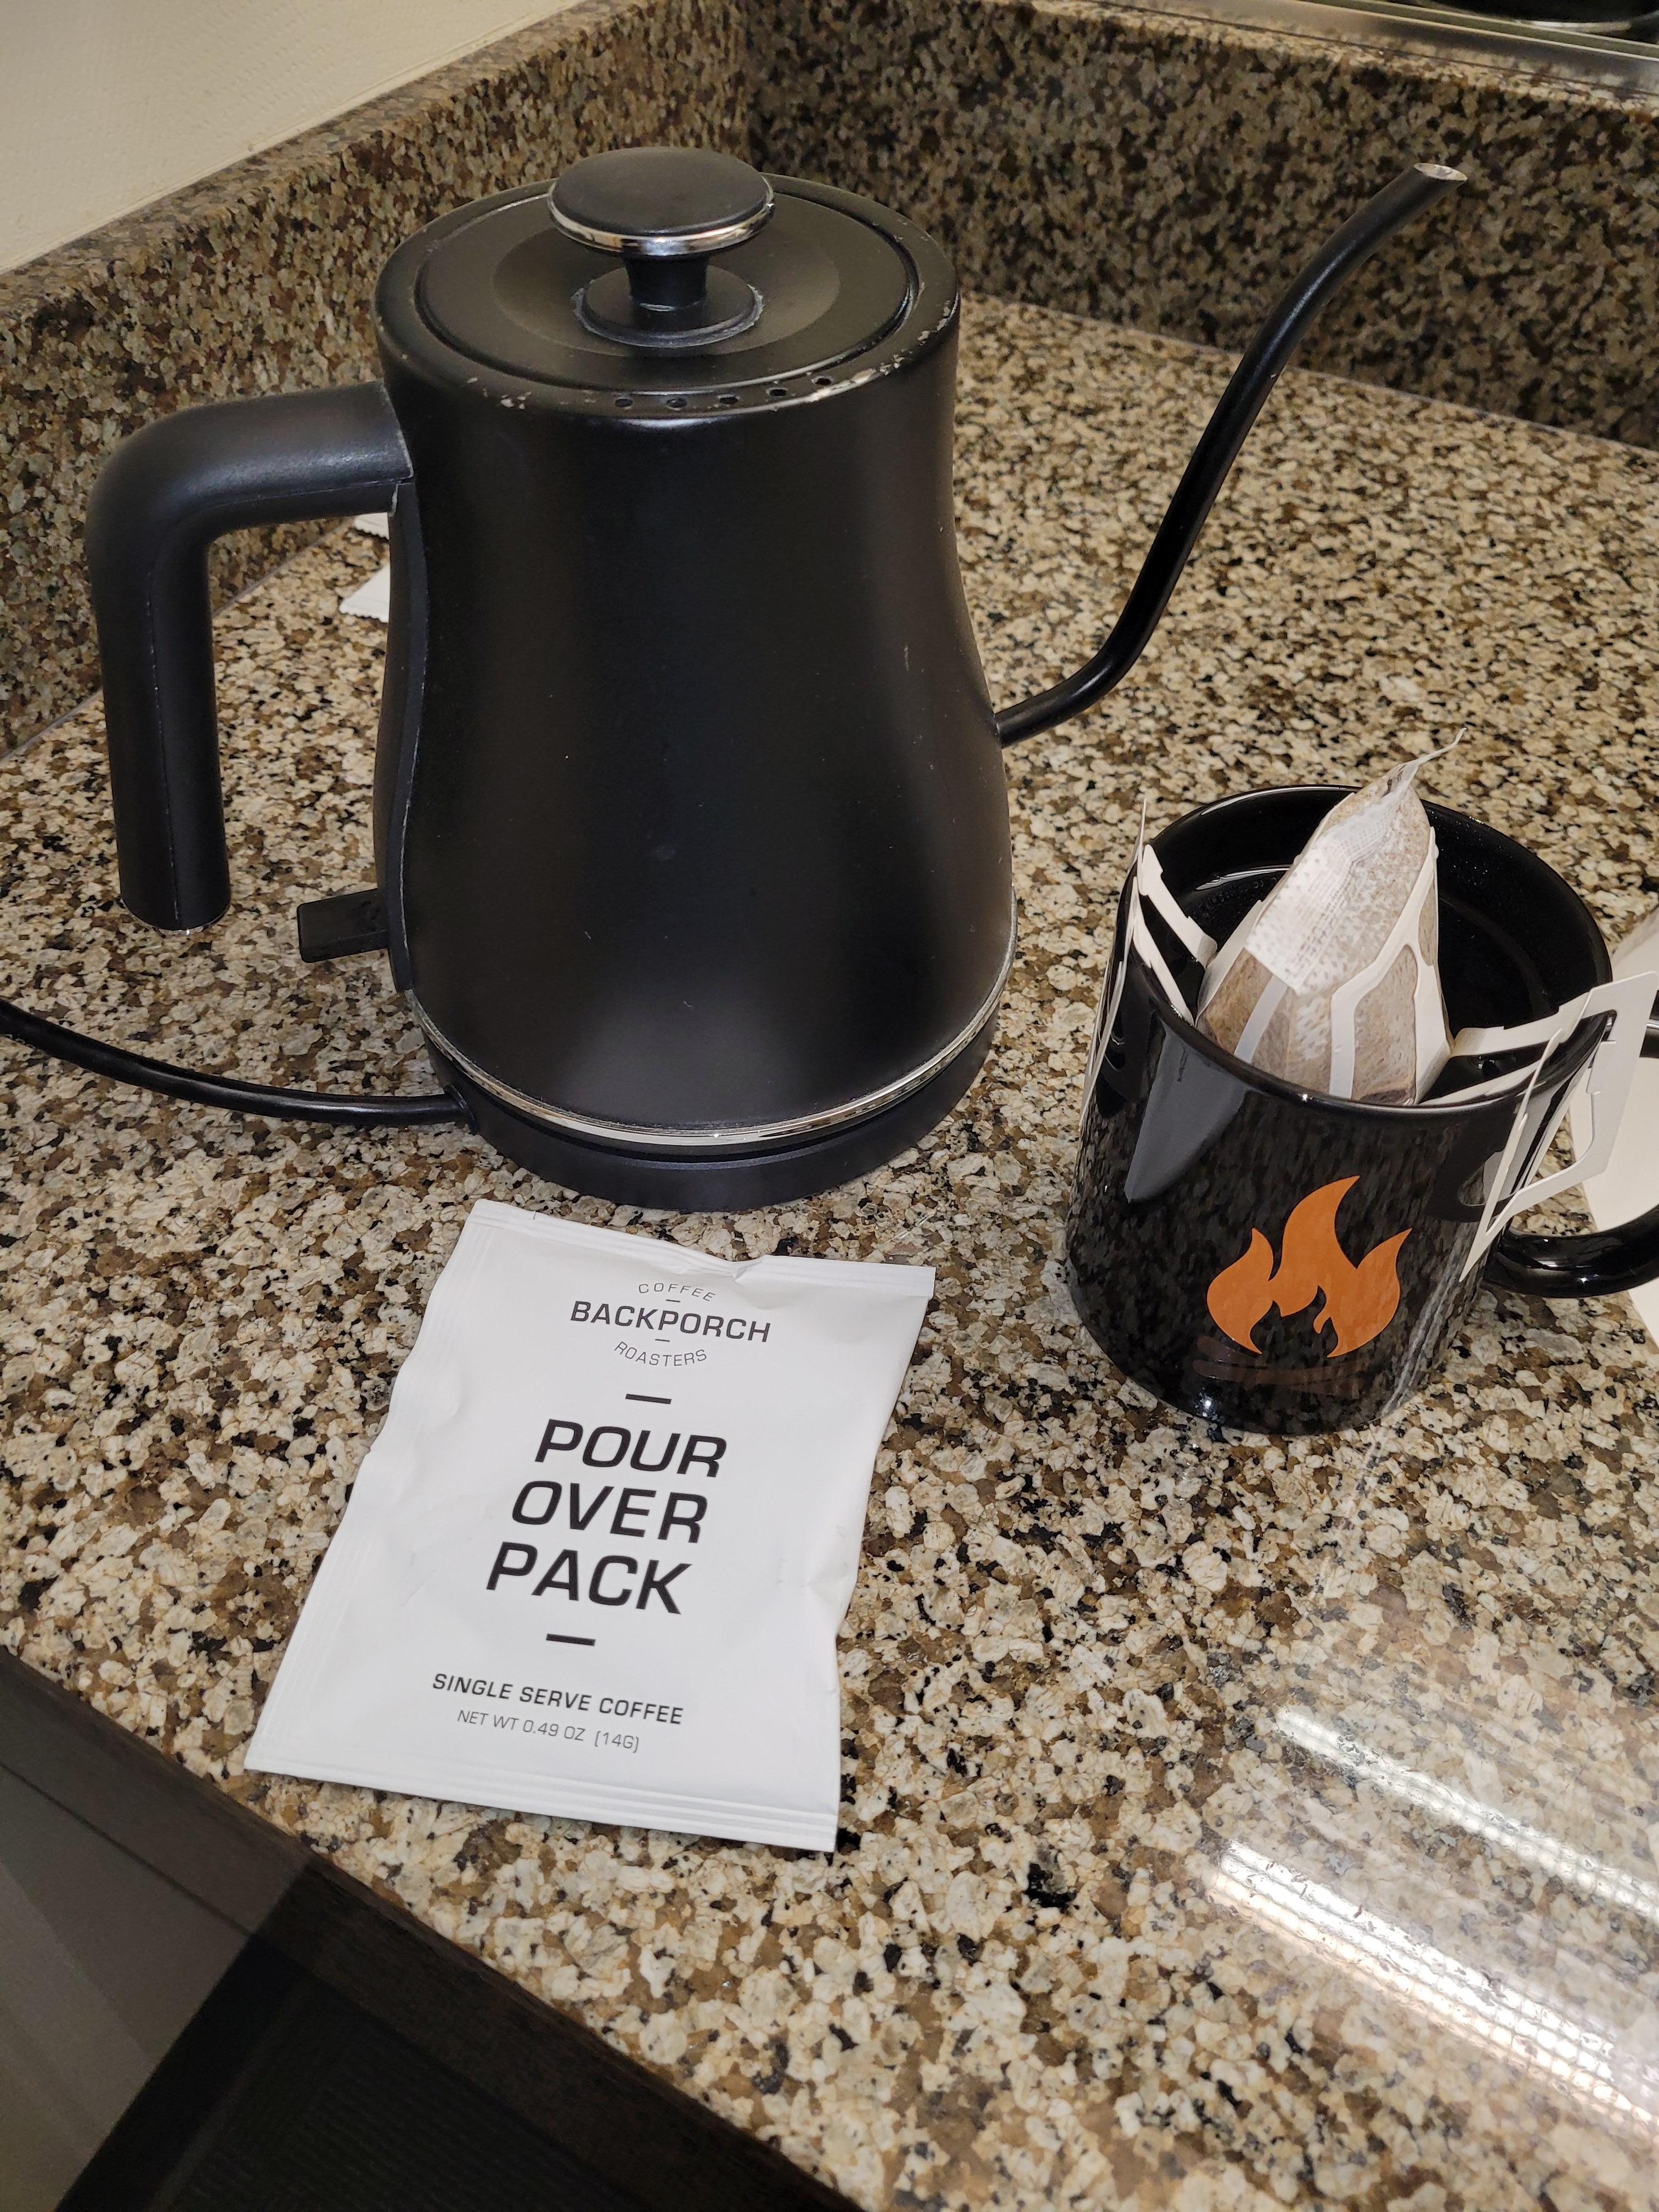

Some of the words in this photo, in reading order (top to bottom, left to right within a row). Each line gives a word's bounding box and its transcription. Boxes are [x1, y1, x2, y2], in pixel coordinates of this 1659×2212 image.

[638, 1282, 716, 1302] COFFEE
[569, 1300, 771, 1344] BACKPORCH
[613, 1340, 708, 1367] ROASTERS
[534, 1418, 727, 1478] POUR
[511, 1480, 709, 1544] OVER
[486, 1541, 693, 1615] PACK
[432, 1672, 514, 1701] SINGLE
[519, 1685, 593, 1712] SERVE
[599, 1697, 684, 1725] COFFEE
[457, 1709, 489, 1726] NET
[494, 1714, 520, 1730] WT
[523, 1719, 559, 1737] 0.49
[563, 1725, 586, 1741] OZ
